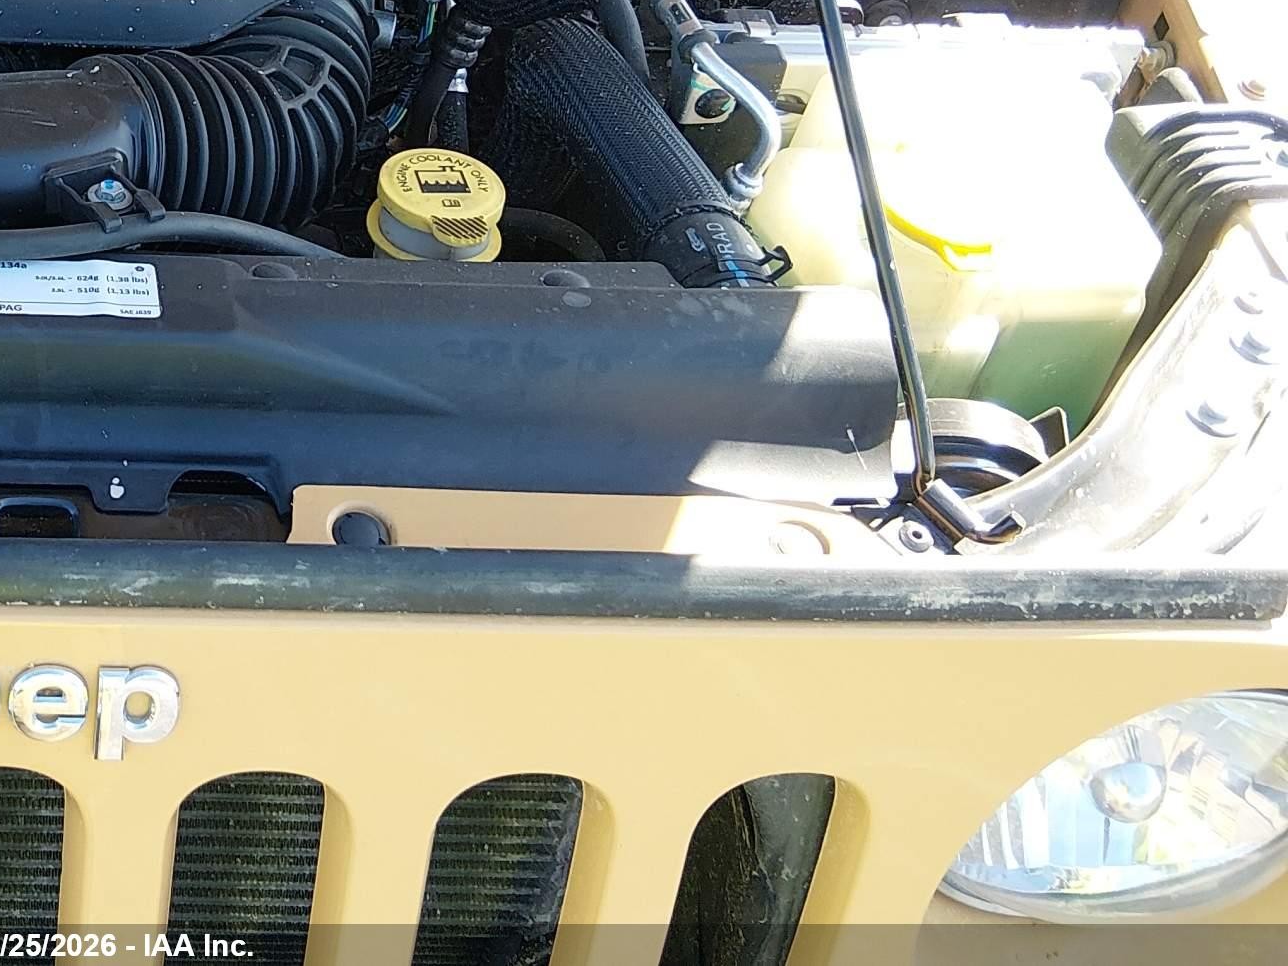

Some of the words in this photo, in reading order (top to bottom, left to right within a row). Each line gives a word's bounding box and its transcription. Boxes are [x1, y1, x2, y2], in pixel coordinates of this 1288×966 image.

[395, 163, 412, 193] ENGINE
[408, 154, 472, 169] COOLANT
[470, 170, 489, 193] ONLY
[706, 222, 735, 254] RAD
[131, 276, 149, 284] lbs)
[132, 288, 150, 296] lbs)
[0, 304, 23, 312] PAG
